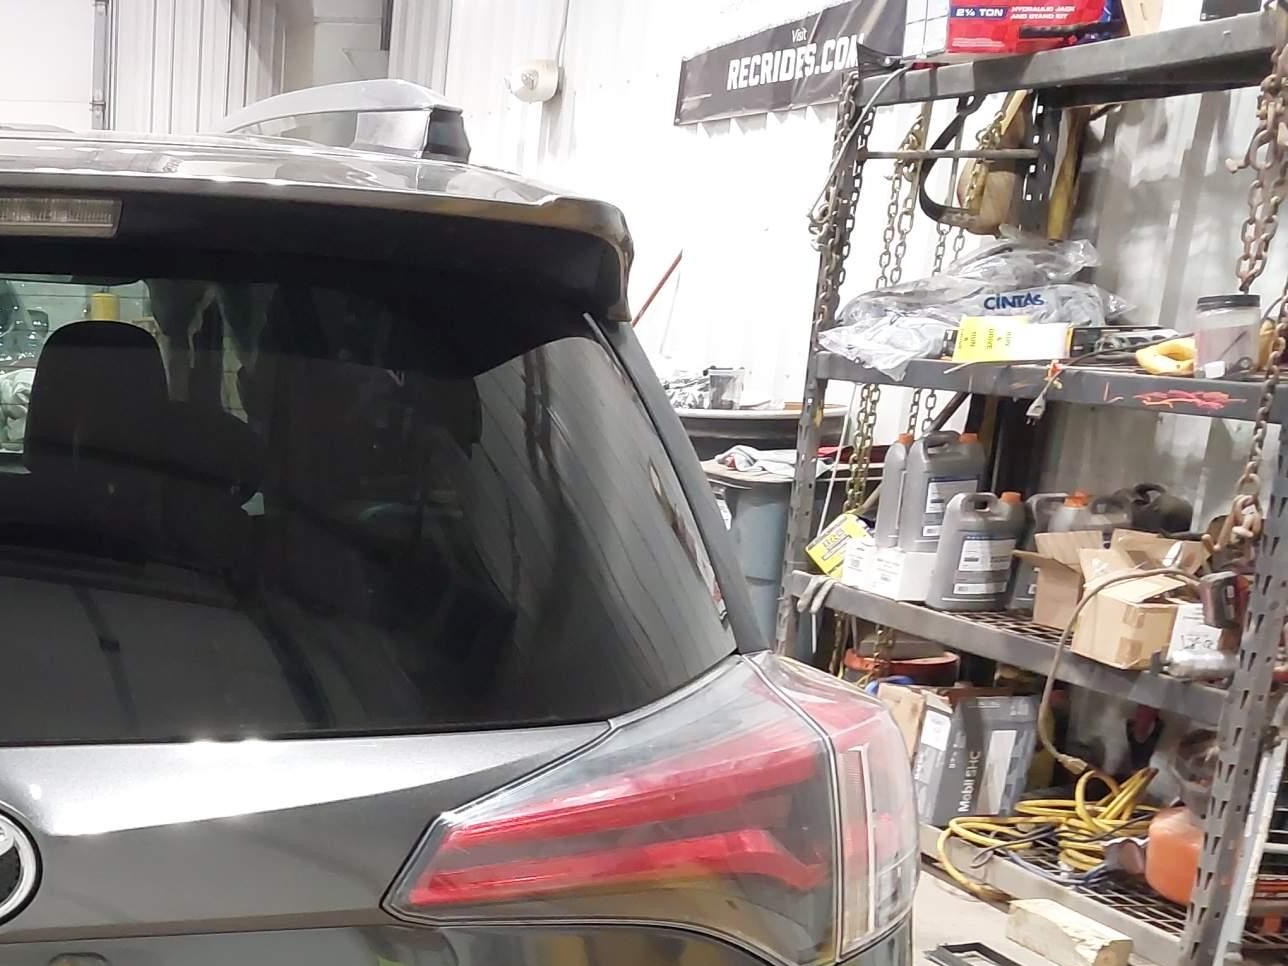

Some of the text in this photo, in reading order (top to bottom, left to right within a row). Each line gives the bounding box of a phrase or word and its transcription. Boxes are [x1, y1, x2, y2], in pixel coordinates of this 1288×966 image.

[979, 8, 1004, 17] TON
[791, 26, 808, 43] Visit
[983, 291, 1045, 310] CINTAS
[964, 750, 982, 778] SHC
[957, 778, 976, 813] Mobil
